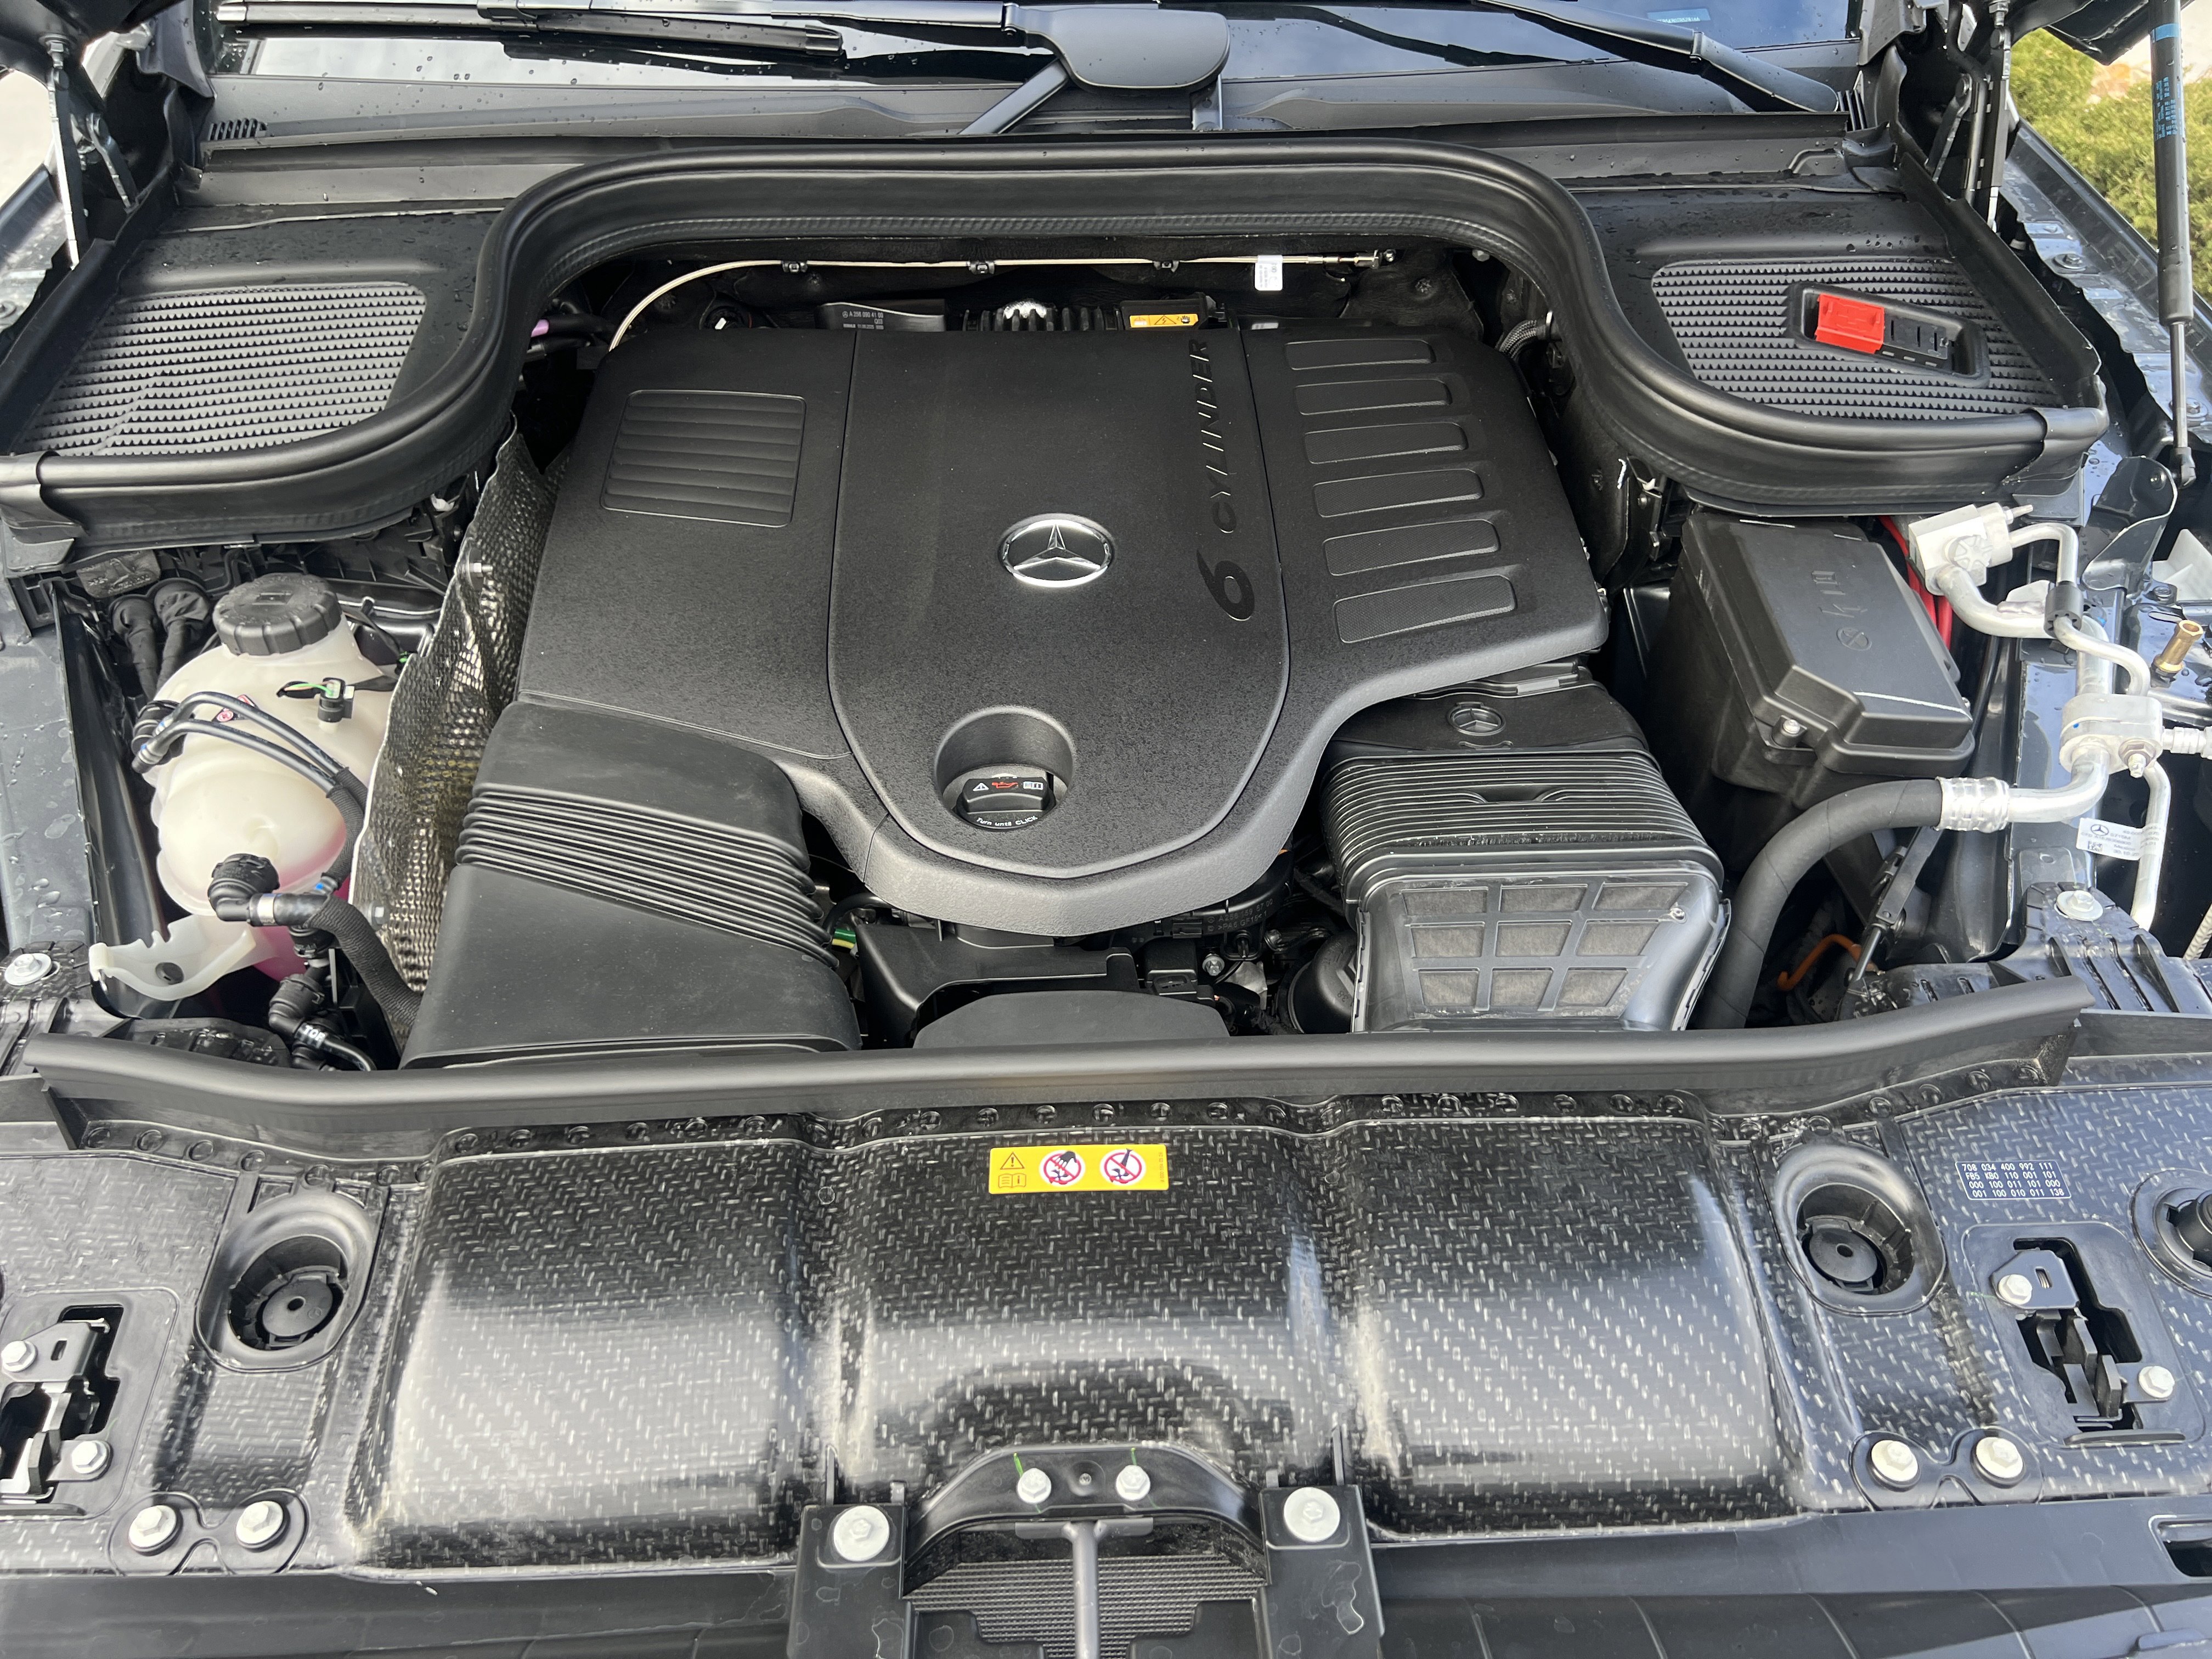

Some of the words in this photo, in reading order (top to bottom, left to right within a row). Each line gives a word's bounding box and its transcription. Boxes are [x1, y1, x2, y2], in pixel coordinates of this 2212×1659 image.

[1188, 338, 1238, 534] CYLINDER
[1196, 549, 1255, 621] 6
[976, 817, 992, 826] Turn
[1015, 815, 1038, 826] CLICK
[303, 1025, 326, 1041] TOP
[1961, 1163, 1977, 1171] 708
[2000, 1163, 2016, 1171] 400
[2019, 1163, 2035, 1171] 992
[2005, 1171, 2019, 1180] 110
[1968, 1181, 1984, 1189] 000
[2029, 1188, 2045, 1197] 011
